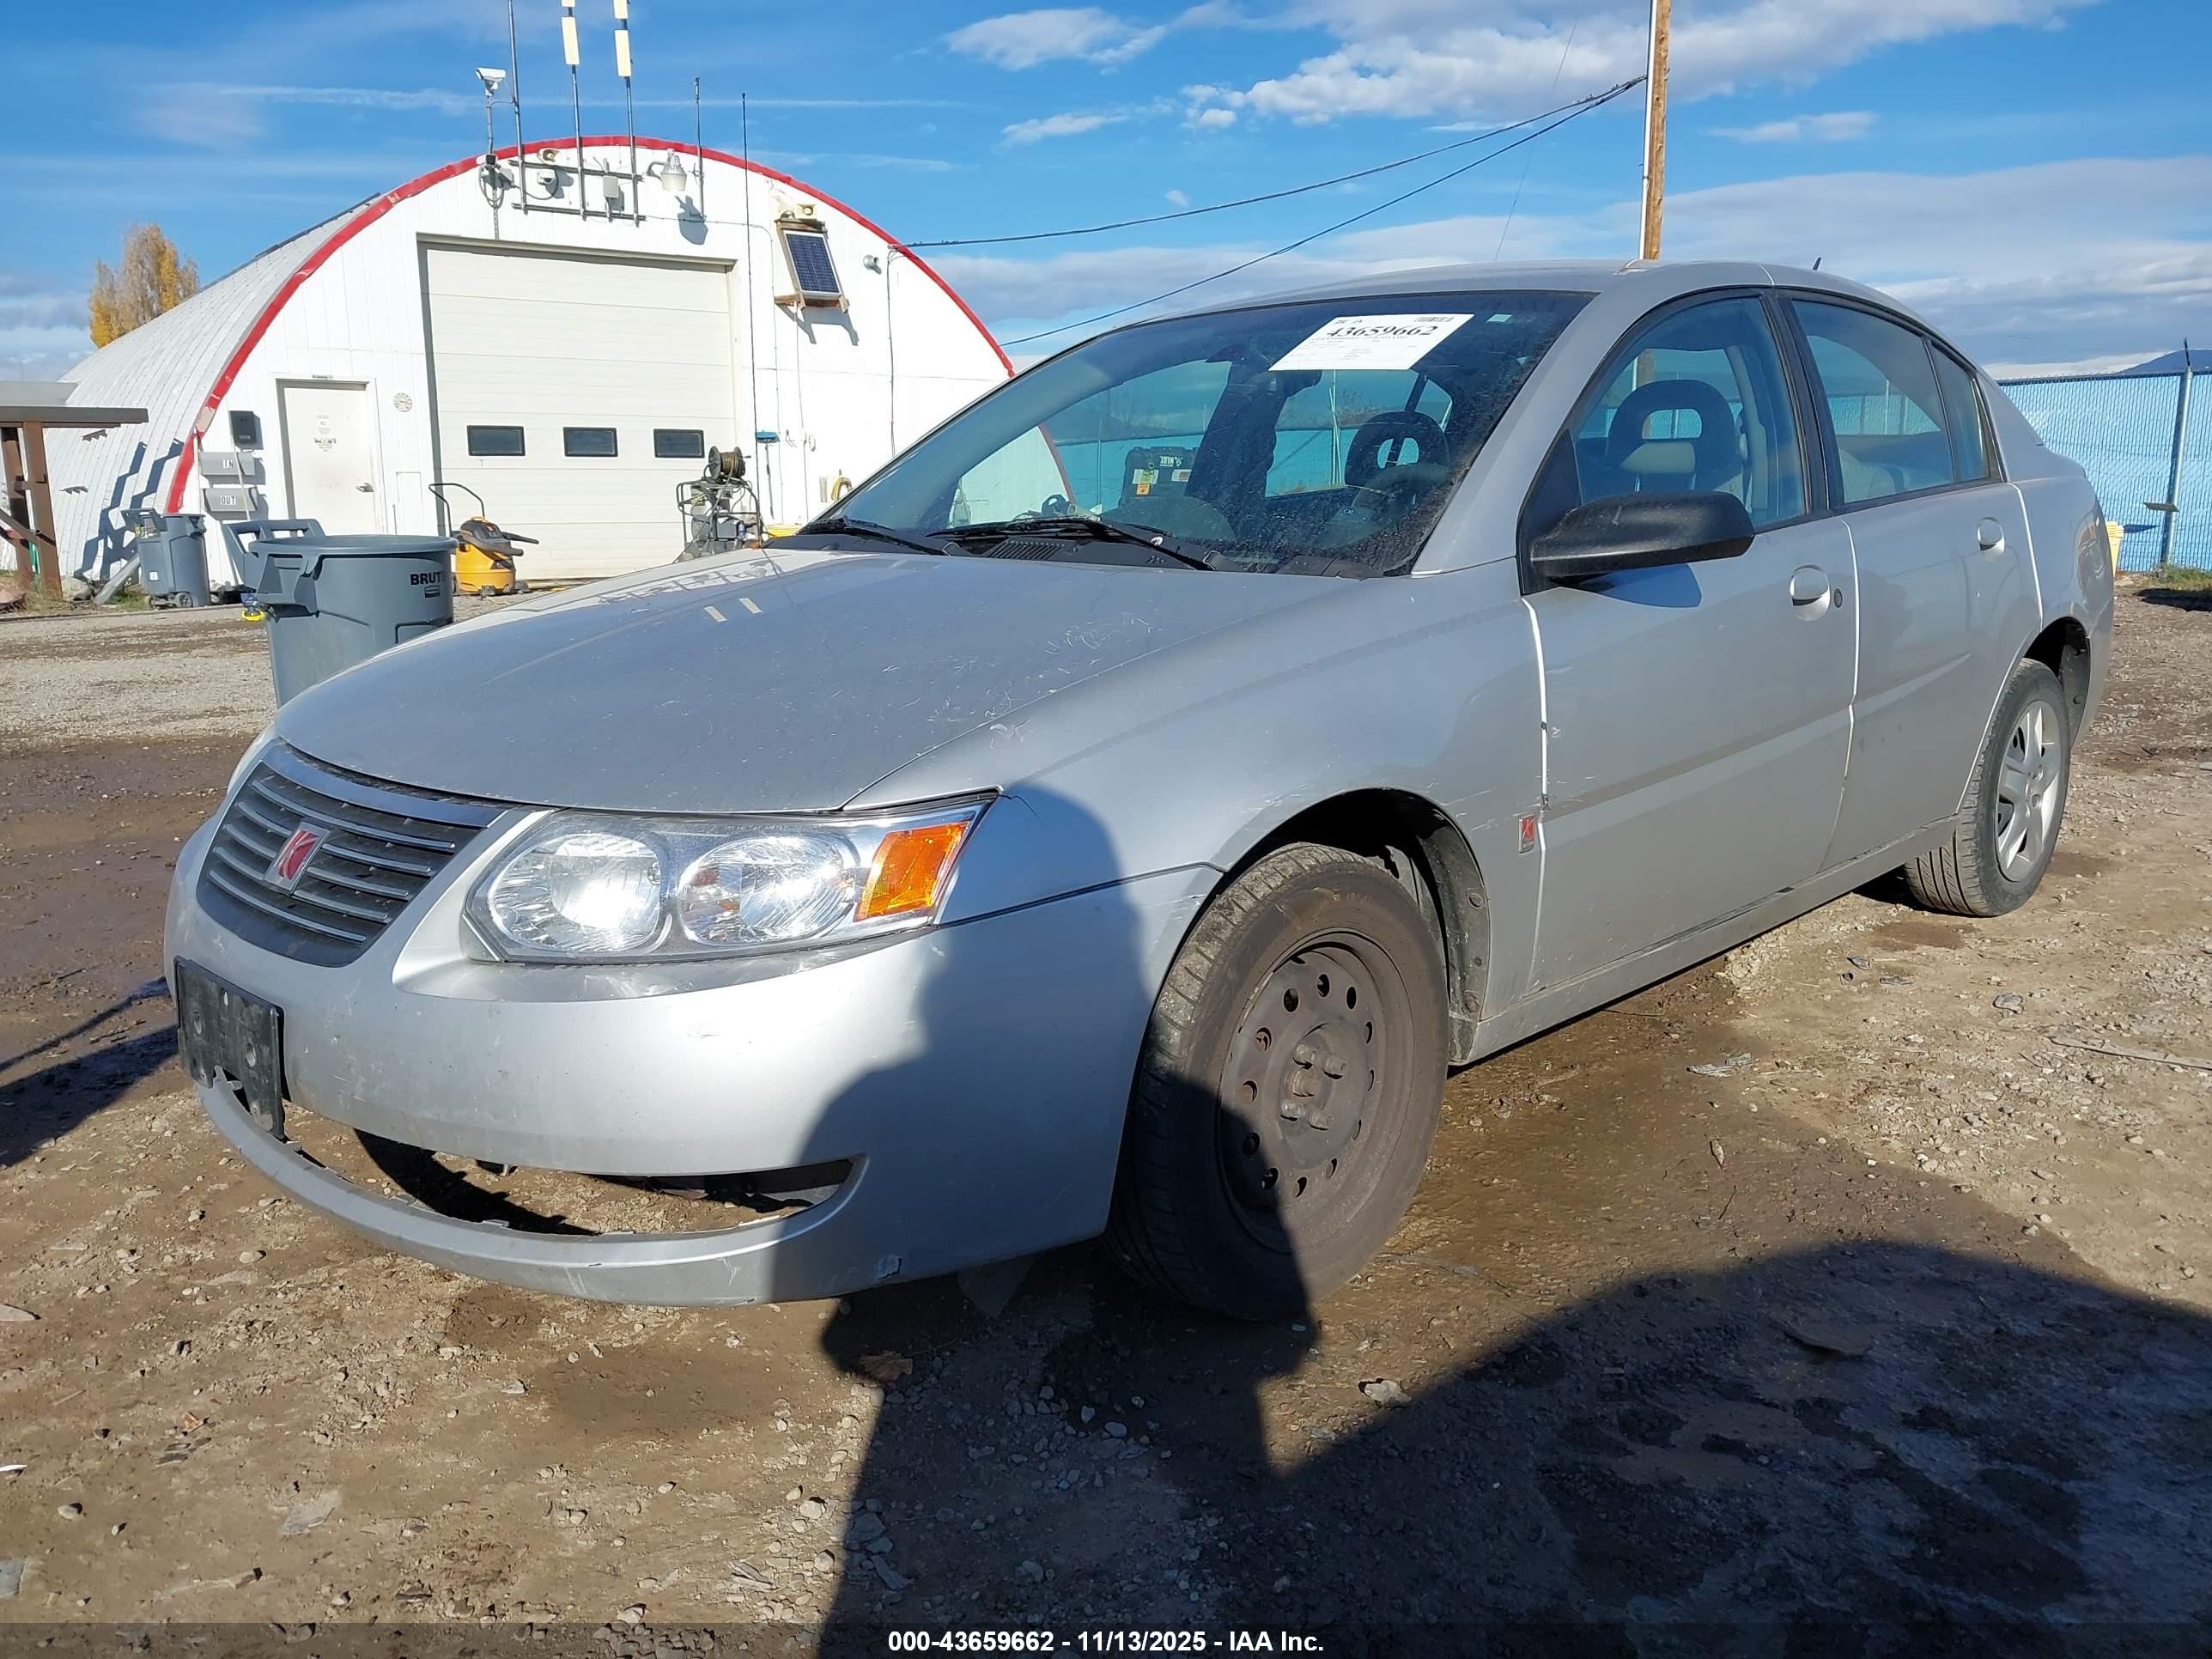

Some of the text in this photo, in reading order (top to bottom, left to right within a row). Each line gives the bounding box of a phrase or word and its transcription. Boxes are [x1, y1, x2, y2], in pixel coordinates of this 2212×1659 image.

[1327, 325, 1439, 337] 43659662
[224, 459, 234, 469] IN
[221, 495, 235, 505] OUT
